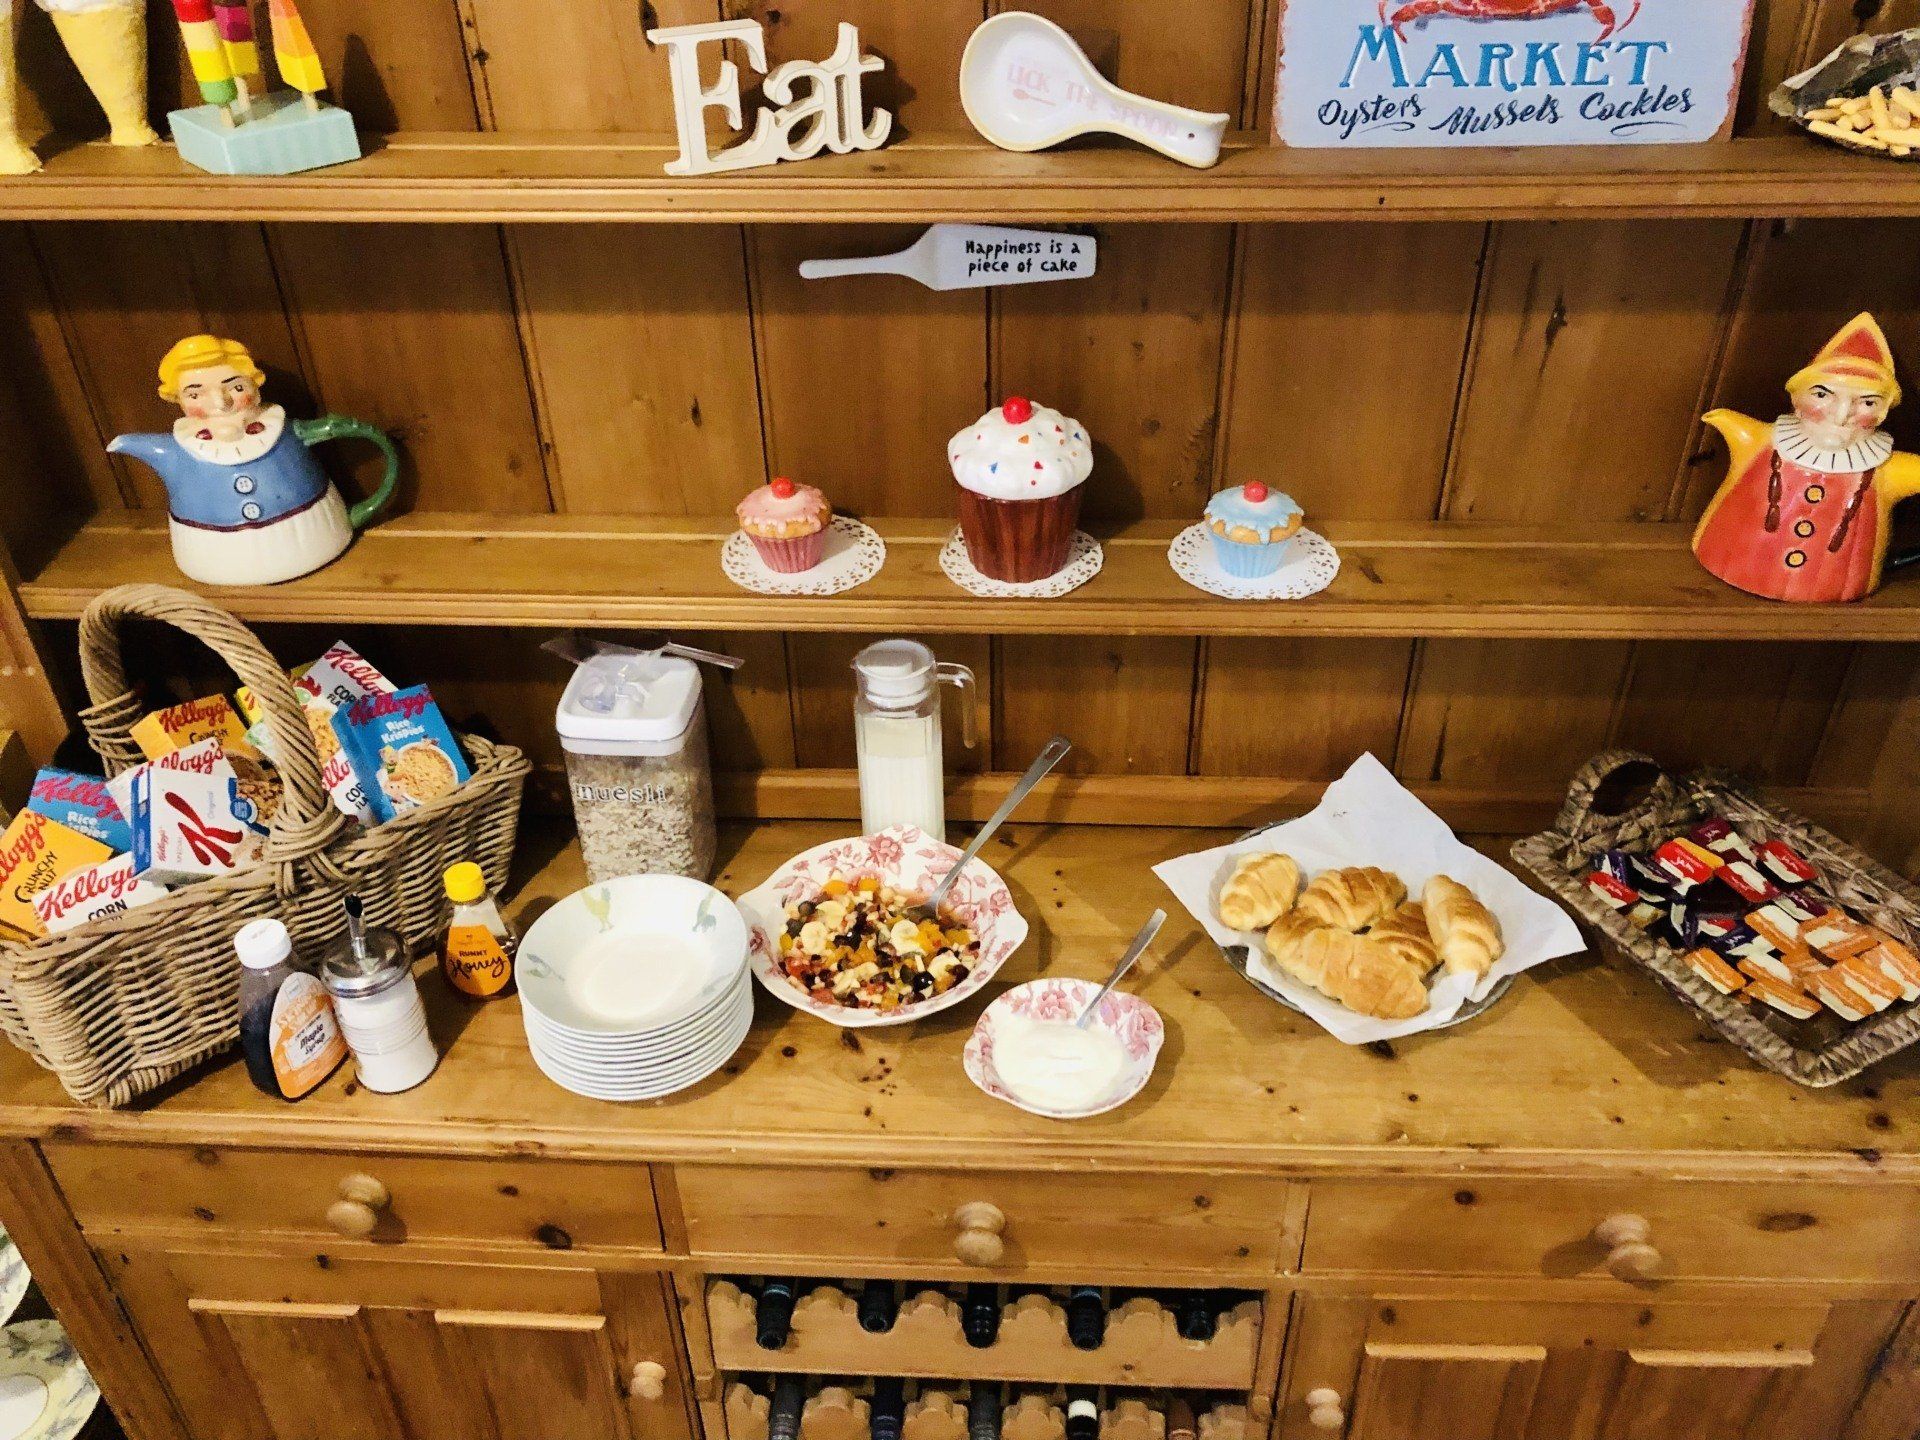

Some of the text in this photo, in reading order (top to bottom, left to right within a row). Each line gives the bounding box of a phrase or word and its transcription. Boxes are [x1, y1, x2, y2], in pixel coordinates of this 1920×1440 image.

[1339, 24, 1669, 89] MARKET
[646, 18, 892, 176] Eat
[1007, 64, 1050, 93] LICK
[1109, 103, 1179, 136] SPOON
[1317, 85, 1696, 140] Oysters Mussels Cockles
[965, 239, 1081, 260] Happiness is a
[968, 258, 1077, 277] piece of cake
[333, 685, 359, 704] COR
[159, 696, 233, 733] Kellogg's
[573, 784, 666, 803] muesli
[14, 851, 58, 903] CRUNCHY
[38, 869, 58, 891] NUT
[459, 949, 488, 957] RUNNY
[449, 956, 508, 979] Honey
